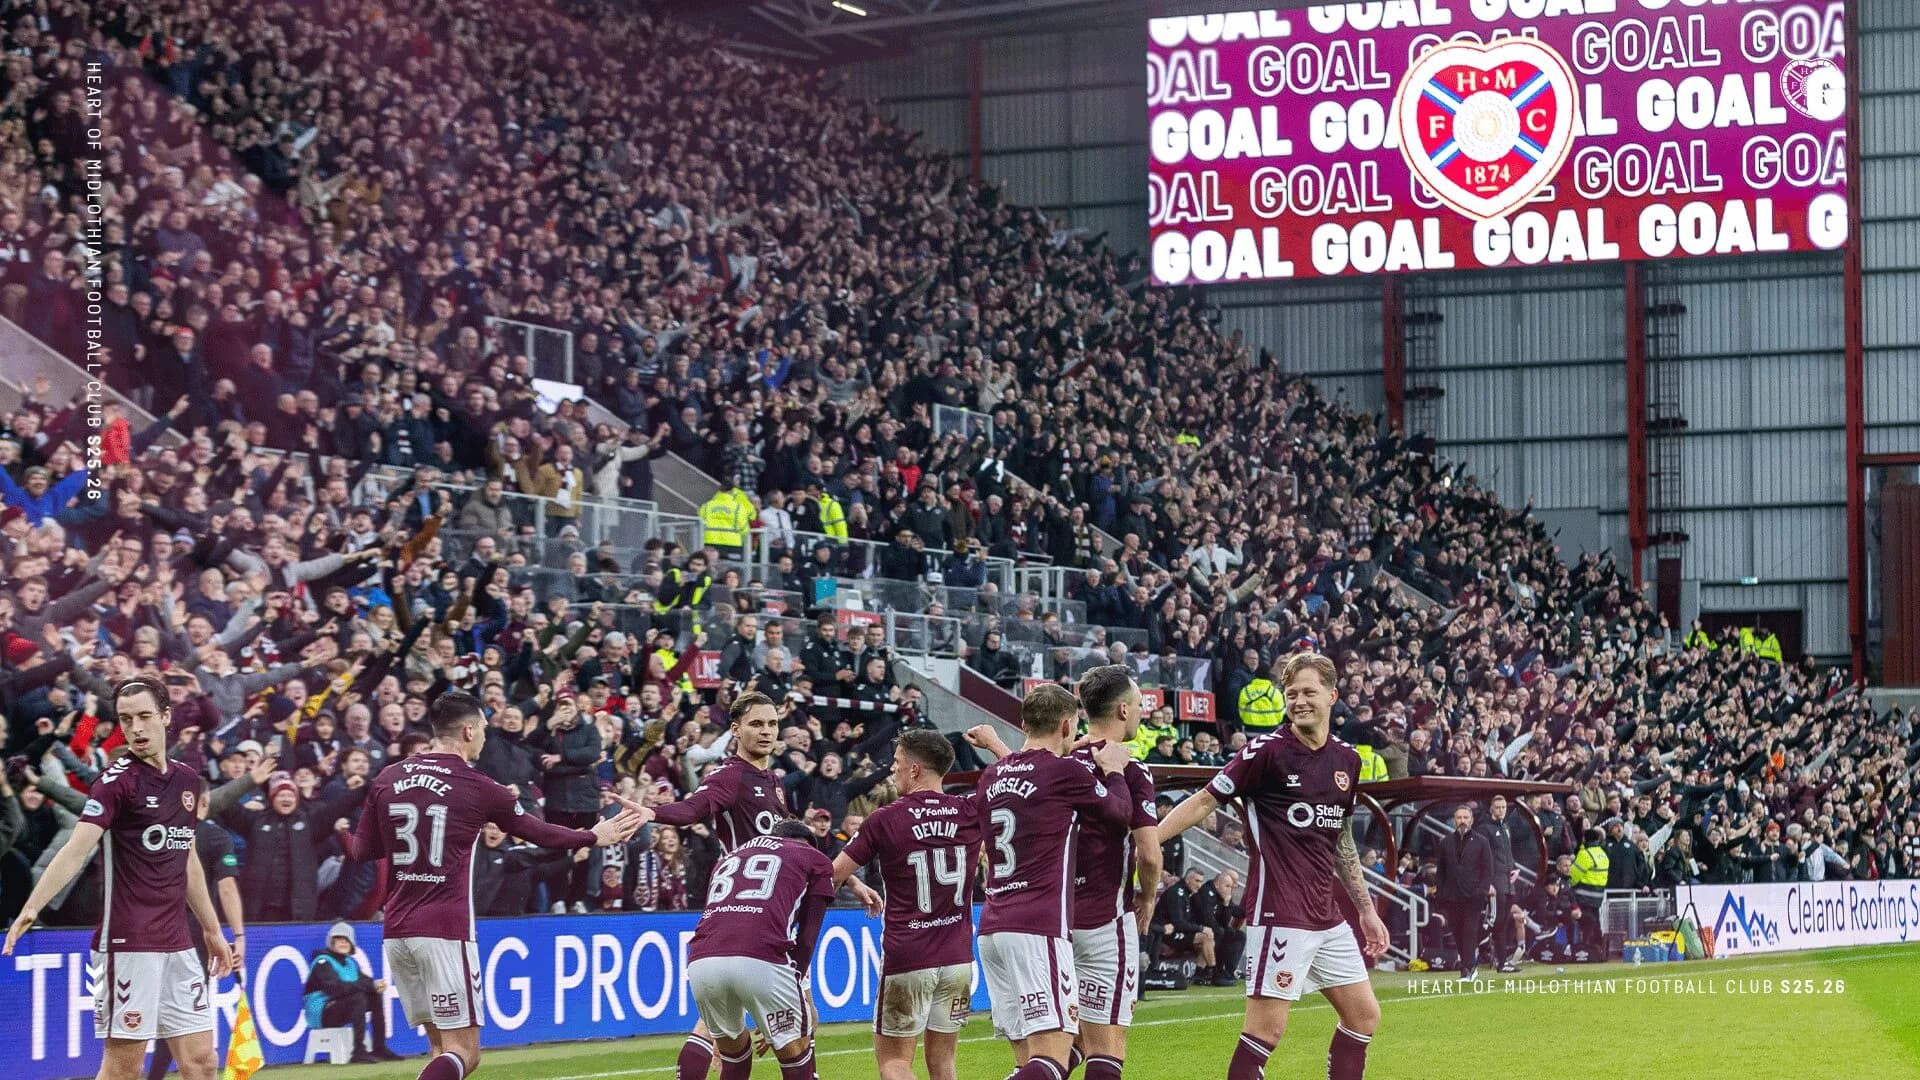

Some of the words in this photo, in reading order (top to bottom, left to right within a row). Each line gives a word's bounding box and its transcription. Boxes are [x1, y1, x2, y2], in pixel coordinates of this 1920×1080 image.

[1248, 38, 1391, 97] GOAL
[1572, 14, 1721, 75] GOAL
[1152, 105, 1293, 164] GOAL
[1636, 72, 1788, 132] GOAL
[1250, 160, 1392, 219] GOAL
[1573, 140, 1723, 200] GOAL
[1464, 164, 1511, 185] 1874
[1153, 227, 1294, 285] GOAL
[1311, 217, 1455, 275] GOAL
[1473, 207, 1620, 267] GOAL
[1638, 198, 1789, 257] GOAL
[986, 778, 1038, 802] KINGSLEY
[388, 802, 449, 868] 31
[912, 821, 959, 840] DEVLIN
[990, 808, 1017, 879] 3
[706, 853, 783, 906] 89
[907, 845, 967, 914] 14
[1788, 882, 1844, 934] Cleland
[1850, 879, 1906, 942] Roofing
[431, 993, 459, 1006] PPE
